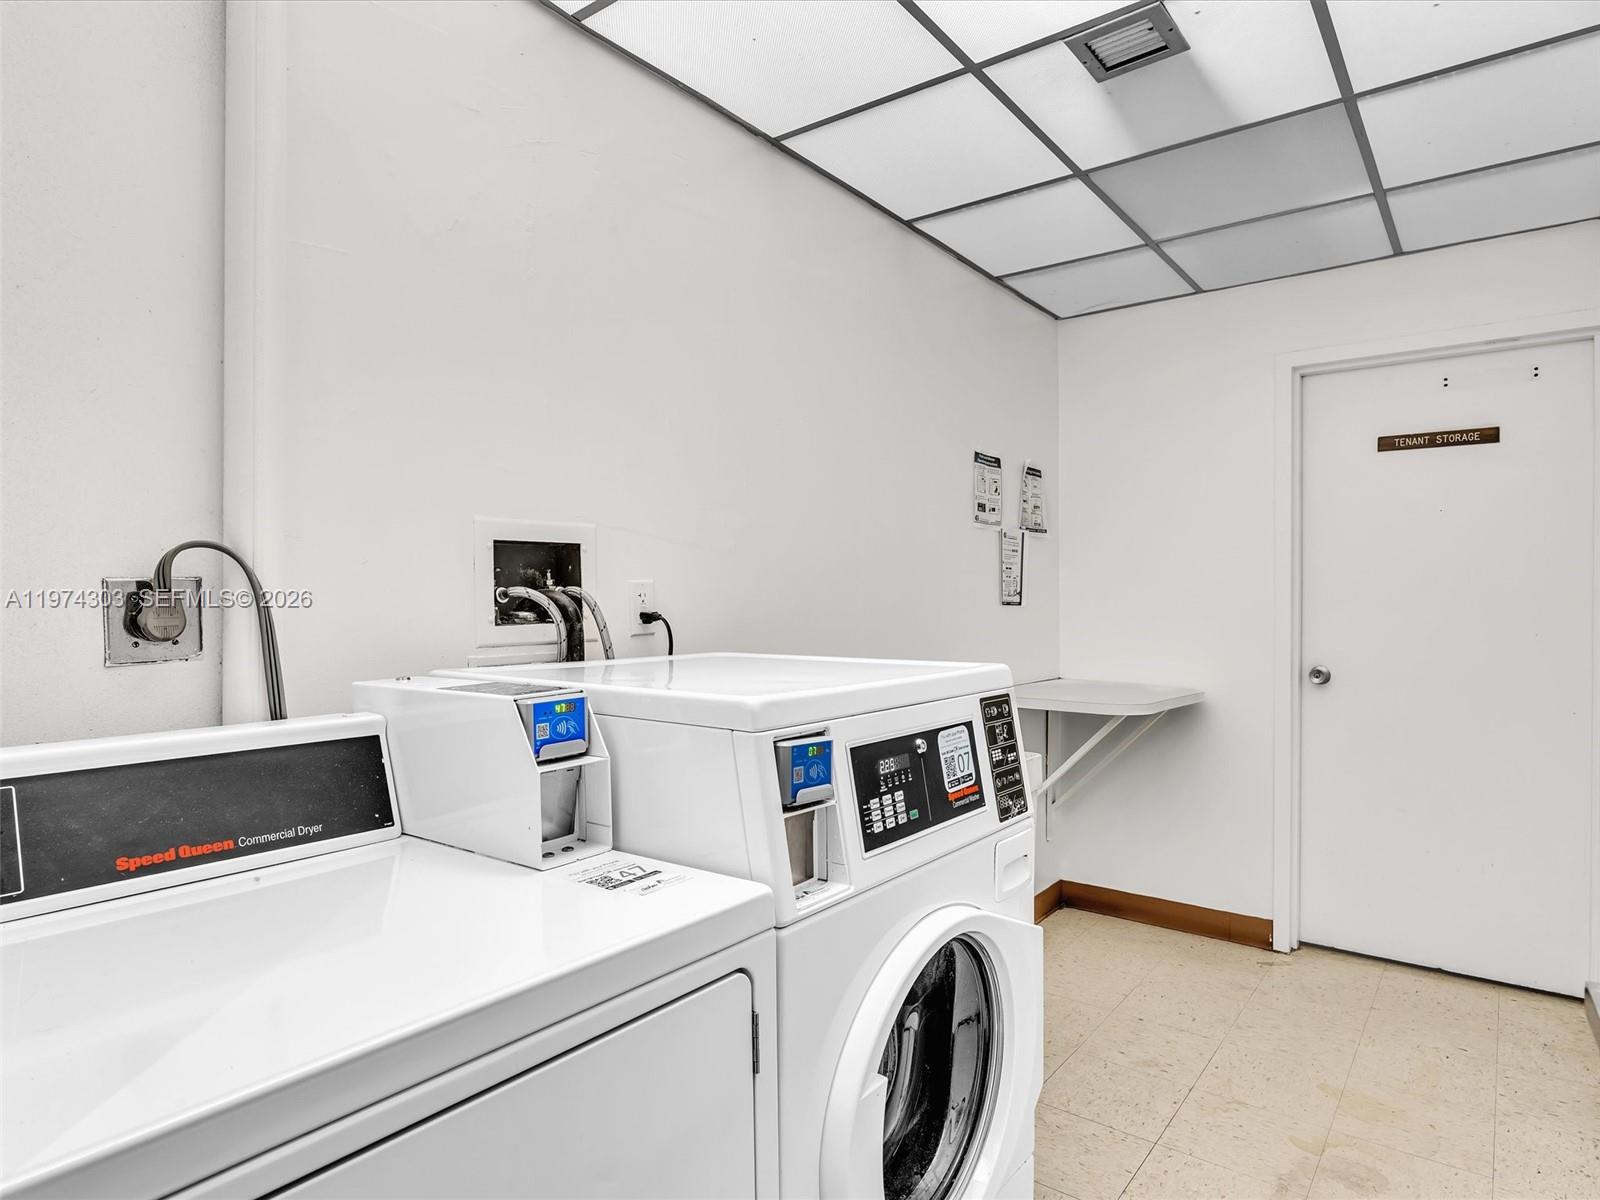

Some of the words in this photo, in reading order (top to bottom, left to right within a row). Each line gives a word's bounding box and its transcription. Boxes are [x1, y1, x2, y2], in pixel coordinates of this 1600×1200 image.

[1394, 436, 1430, 447] TENANT
[1435, 431, 1481, 444] STORAGE
[957, 751, 970, 773] 07
[115, 847, 176, 872] Speed
[177, 838, 235, 859] Queen
[238, 827, 296, 848] Commercial
[298, 823, 323, 837] Dryer
[619, 865, 647, 878] 47
